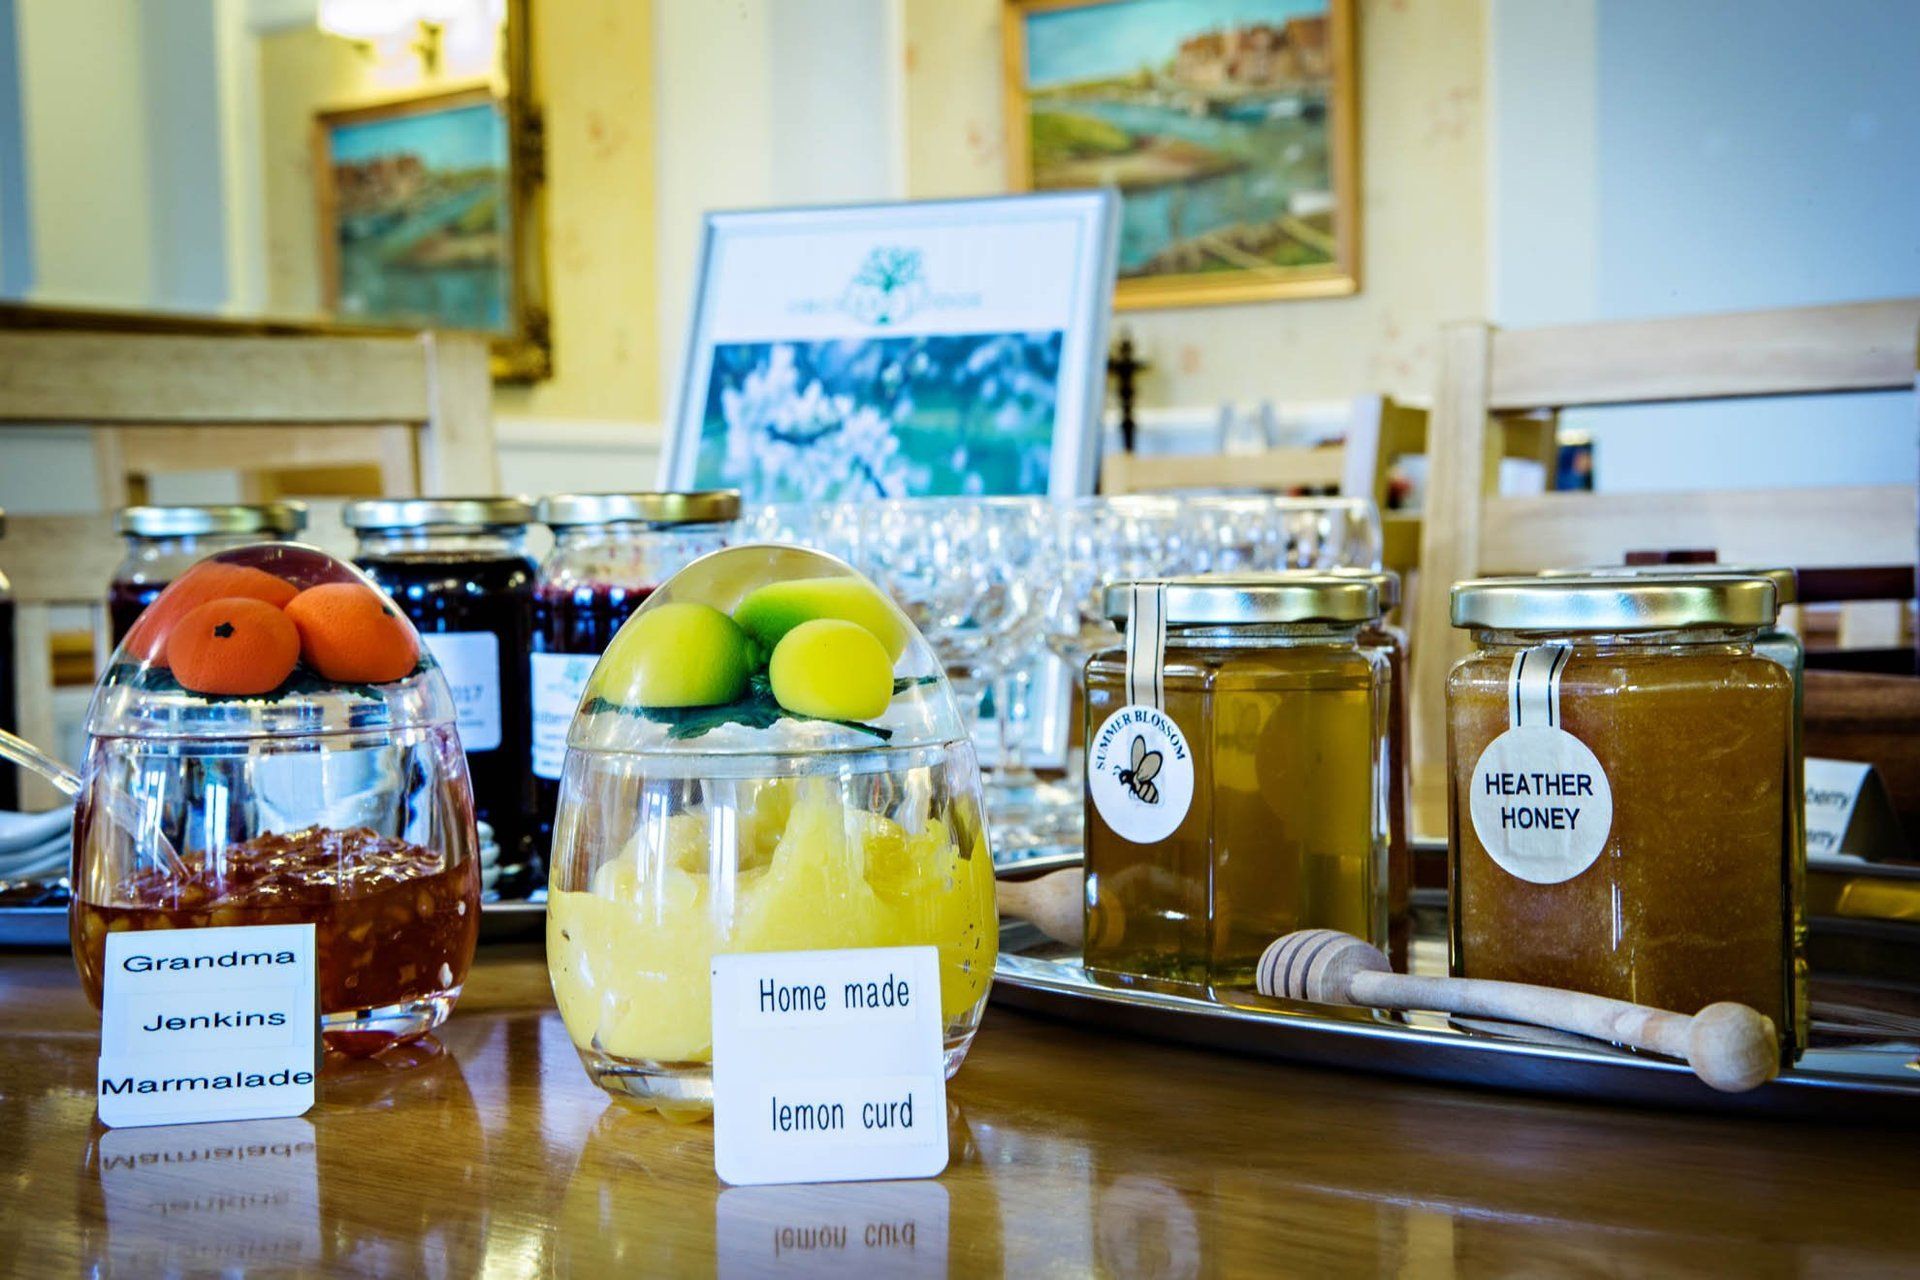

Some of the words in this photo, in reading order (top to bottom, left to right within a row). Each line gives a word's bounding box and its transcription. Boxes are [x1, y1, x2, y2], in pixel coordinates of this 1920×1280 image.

[1096, 713, 1132, 770] SUMMER
[1134, 710, 1186, 760] BLOSSOM
[1485, 773, 1593, 796] HEATHER
[1501, 806, 1580, 830] HONEY
[123, 951, 296, 973] Grandma
[759, 978, 826, 1012] Home
[844, 973, 909, 1009] made
[143, 1011, 286, 1032] Jenkins
[101, 1069, 314, 1096] Marmalade
[772, 1096, 844, 1132] lemon
[862, 1093, 913, 1129] curd
